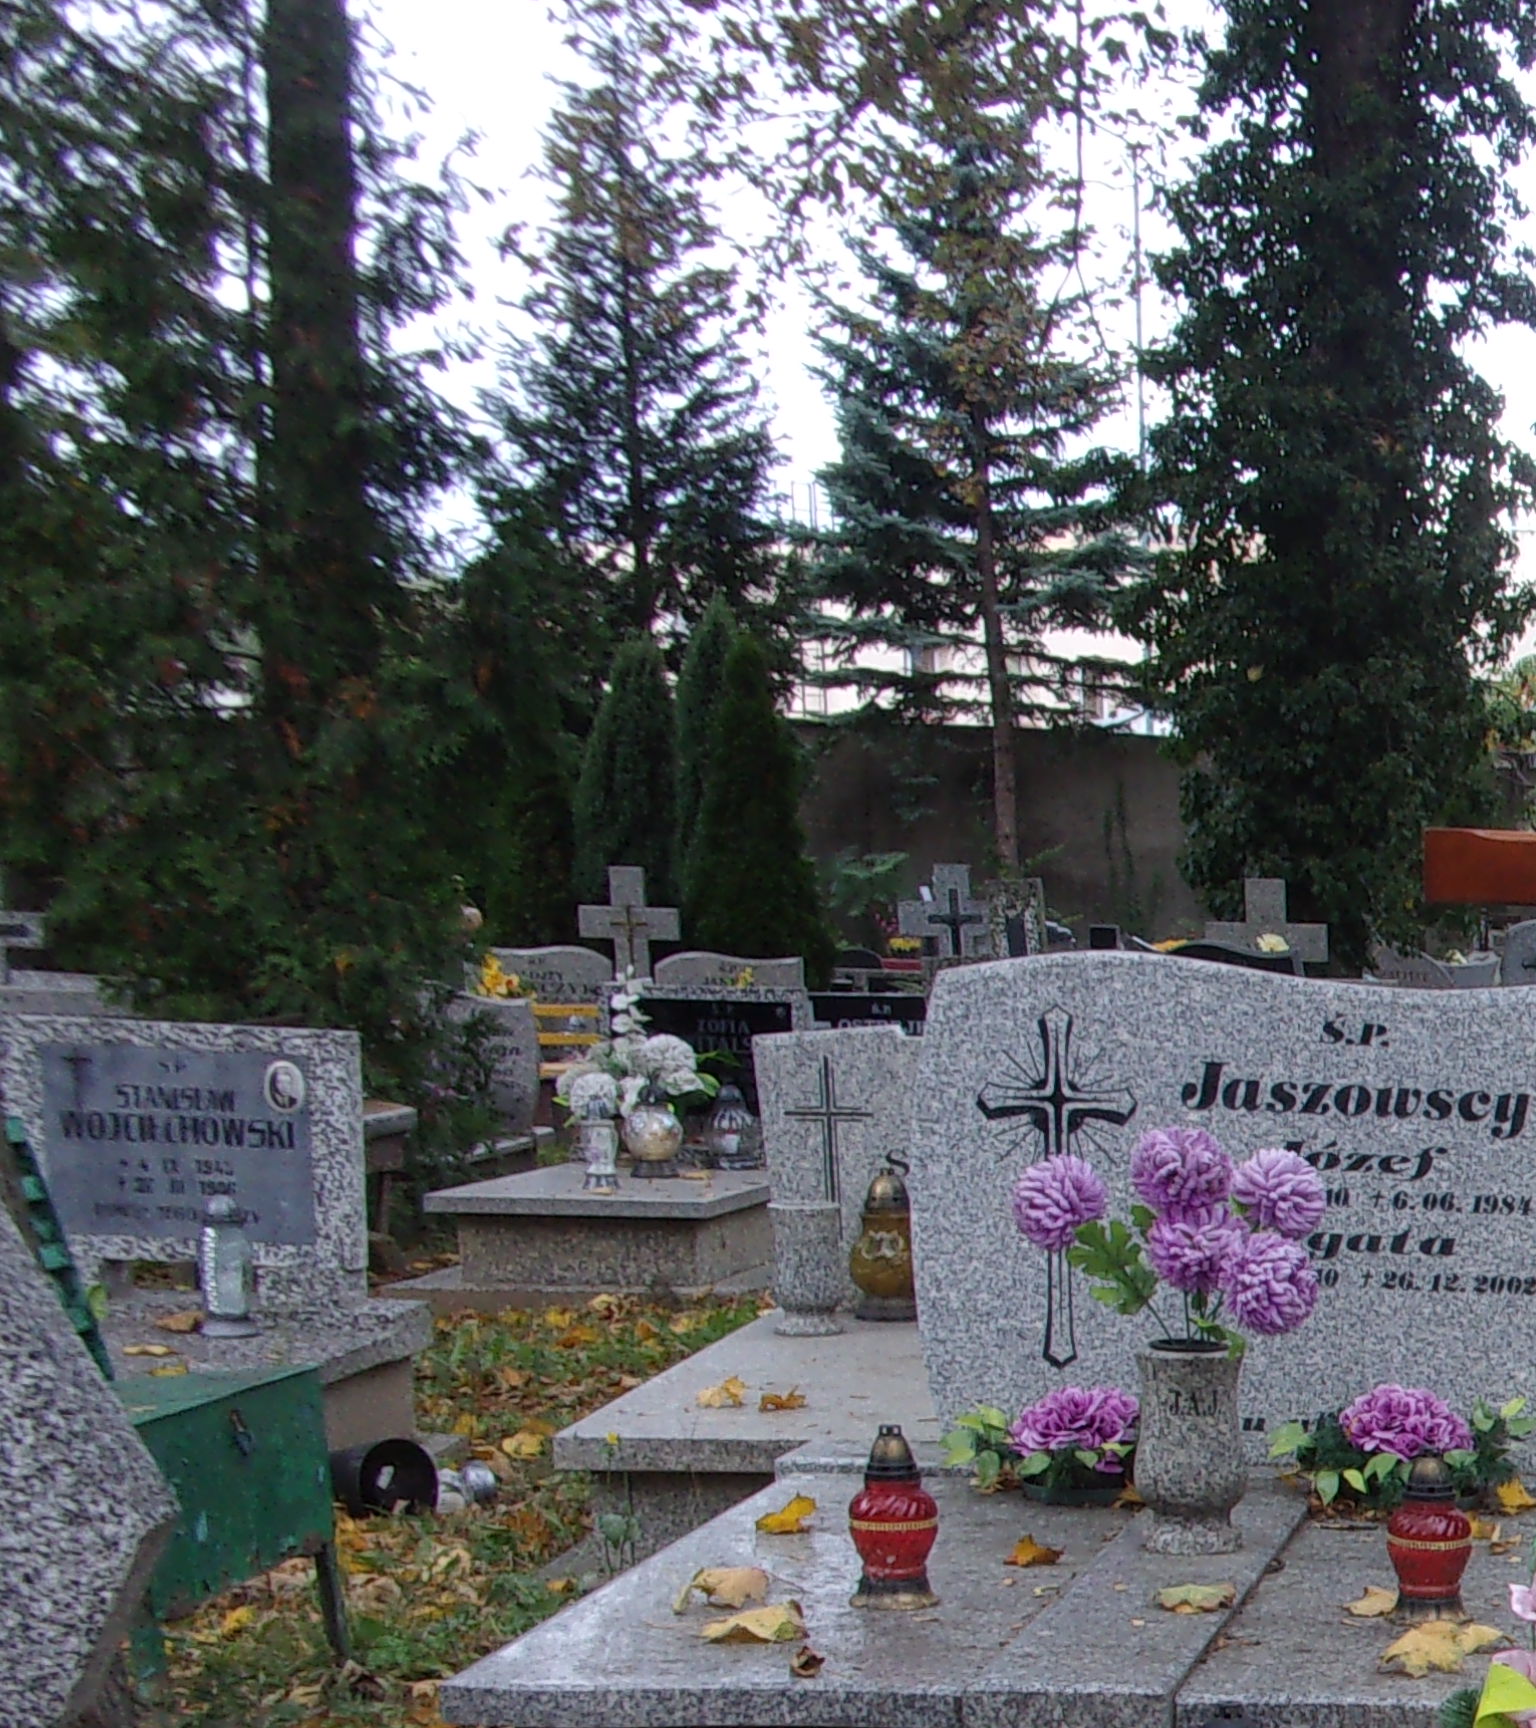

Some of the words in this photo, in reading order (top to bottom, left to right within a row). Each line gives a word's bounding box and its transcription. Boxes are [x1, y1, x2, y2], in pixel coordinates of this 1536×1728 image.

[1180, 1060, 1532, 1140] Jaszowscy
[1471, 1194, 1534, 1216] 1984
[1306, 1229, 1457, 1260] gata
